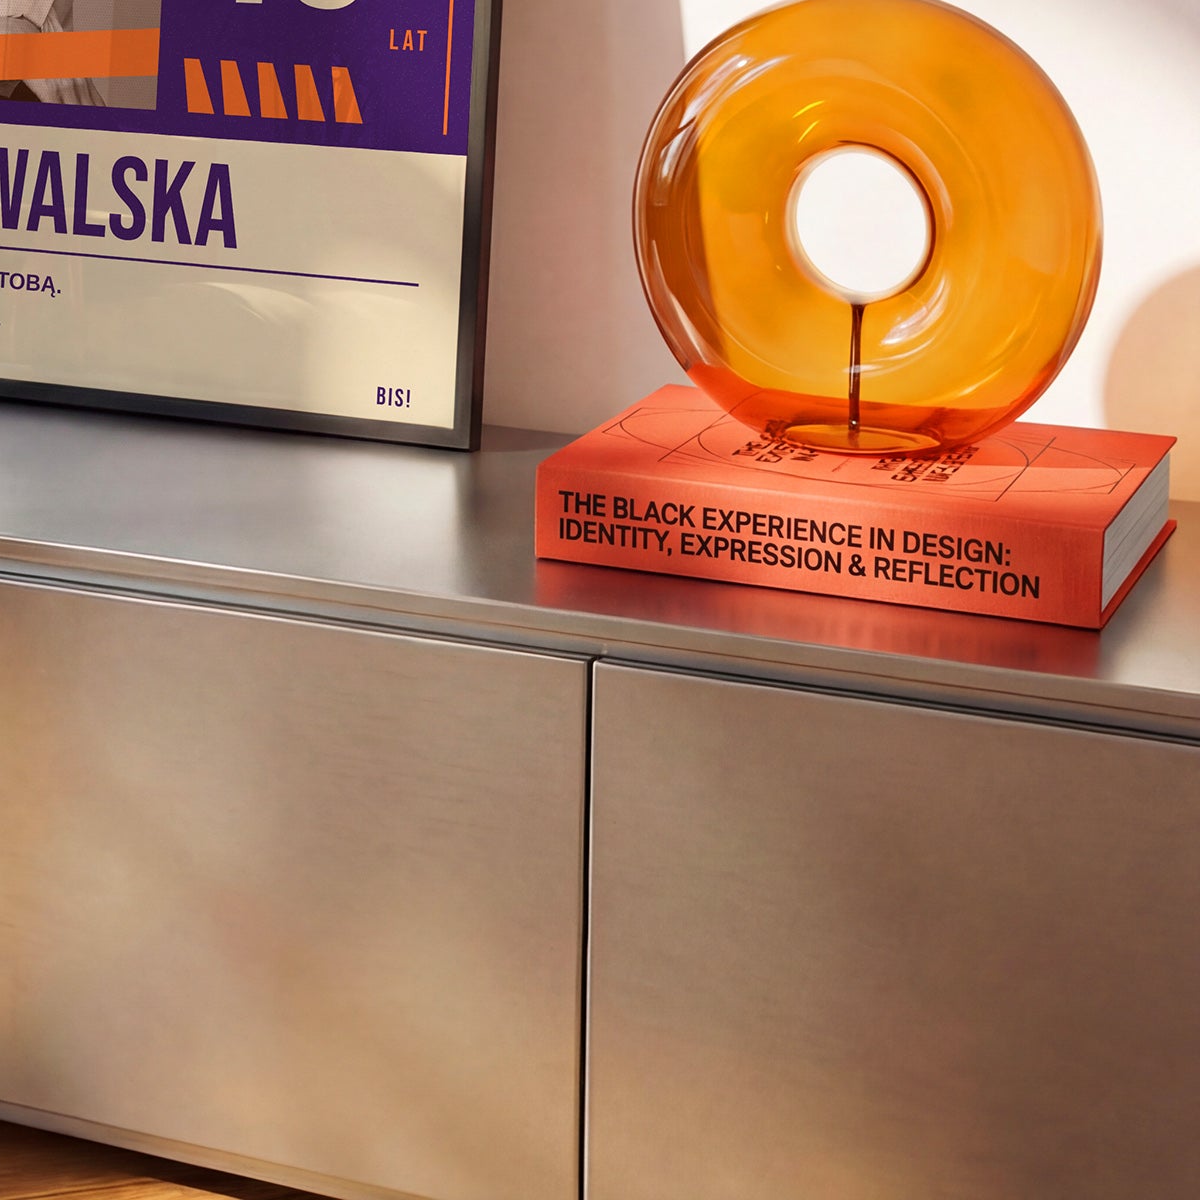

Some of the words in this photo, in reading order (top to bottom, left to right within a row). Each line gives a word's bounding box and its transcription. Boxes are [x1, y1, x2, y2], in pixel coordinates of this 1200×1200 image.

[389, 29, 427, 51] LAT
[376, 386, 410, 408] BIS!
[558, 490, 607, 518] THE
[612, 497, 696, 529] BLACK
[702, 507, 863, 550] EXPERIENCE
[869, 527, 895, 551] IN
[902, 531, 1012, 567] DESIGN:
[558, 517, 675, 557] IDENTITY,
[680, 535, 843, 575] EXPRESSION
[848, 553, 867, 578] &
[873, 556, 1041, 599] REFLECTION
